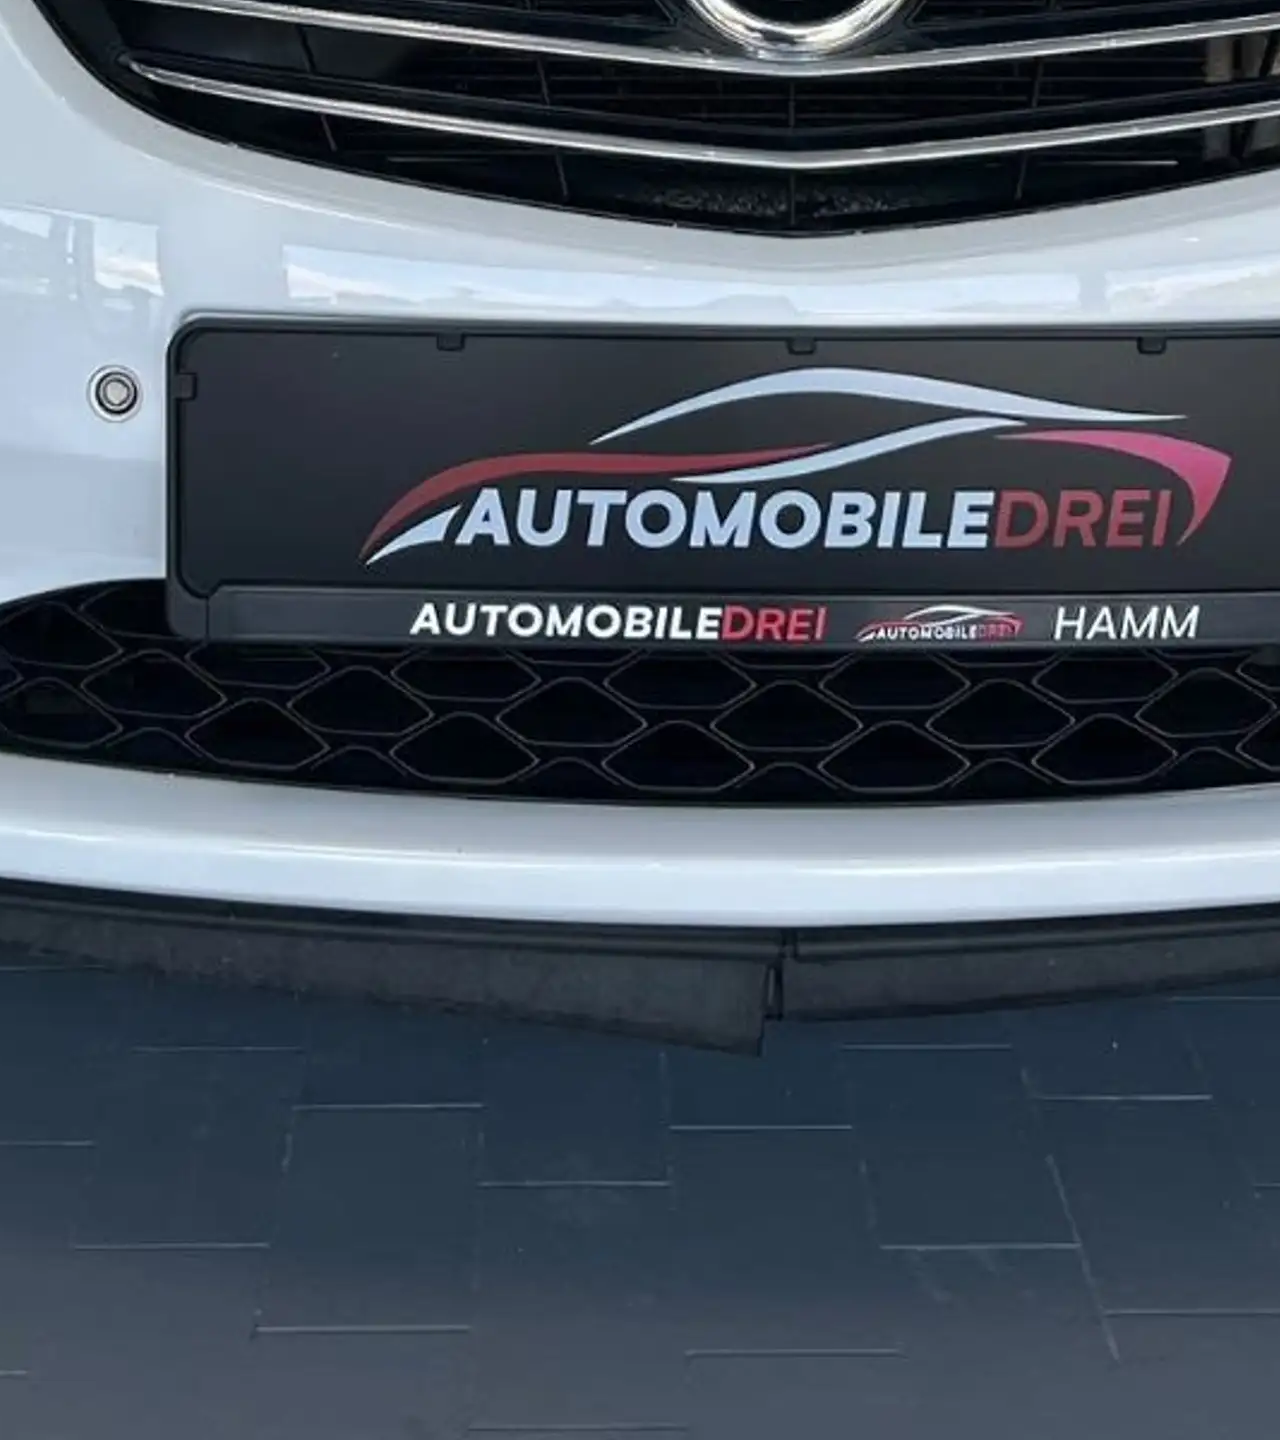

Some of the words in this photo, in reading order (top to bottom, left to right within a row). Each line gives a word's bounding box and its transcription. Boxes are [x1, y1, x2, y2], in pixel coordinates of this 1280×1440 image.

[454, 488, 1173, 549] AUTOMOBILEDREI
[409, 603, 827, 641] AUTOMOBILEDREI
[1053, 605, 1201, 641] HAMM
